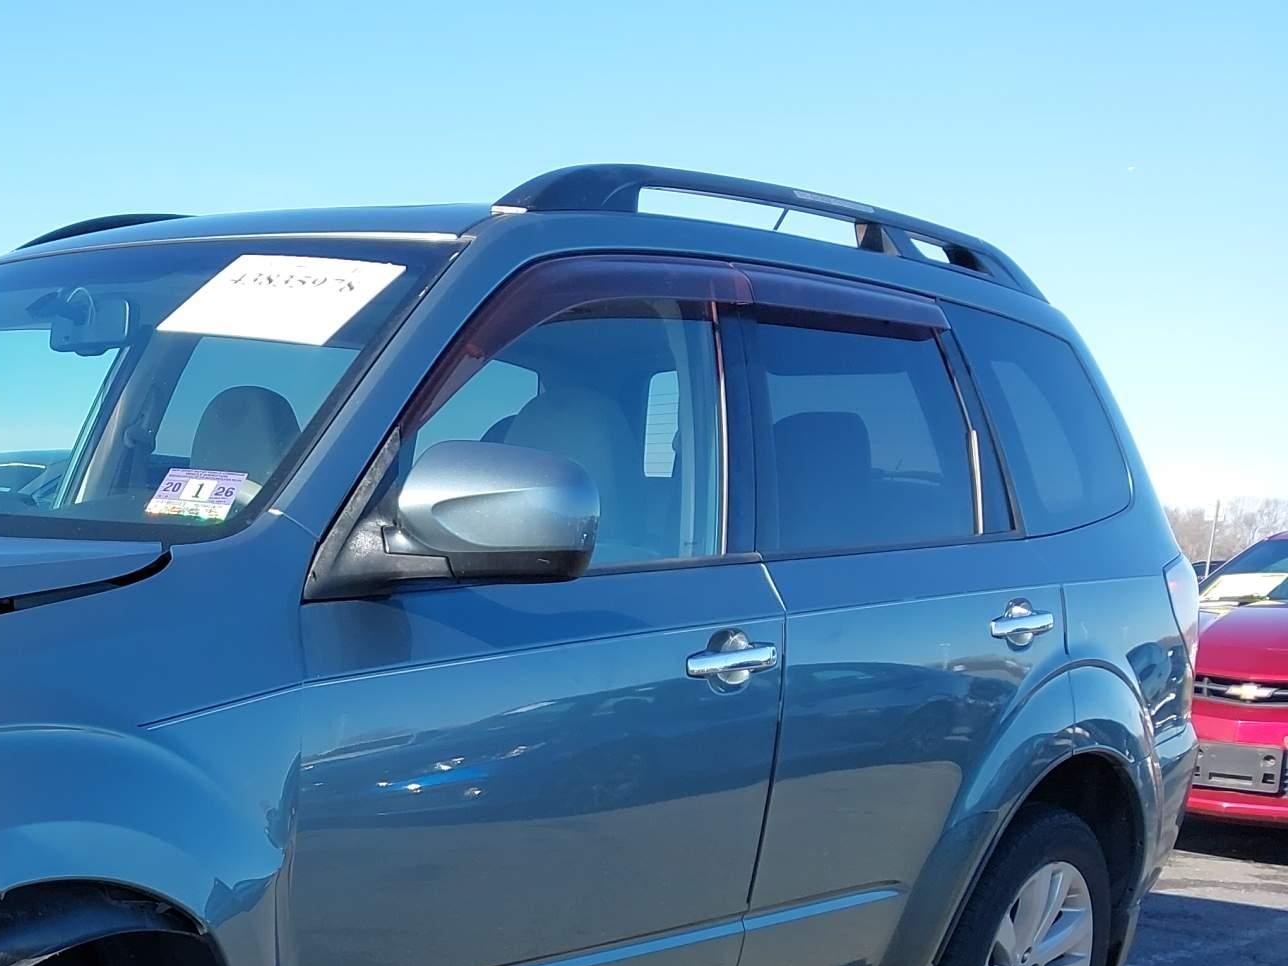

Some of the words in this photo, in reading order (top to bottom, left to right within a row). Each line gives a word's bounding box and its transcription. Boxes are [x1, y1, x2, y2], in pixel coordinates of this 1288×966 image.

[162, 482, 182, 493] 20
[192, 483, 205, 498] 1
[214, 486, 236, 498] 26
